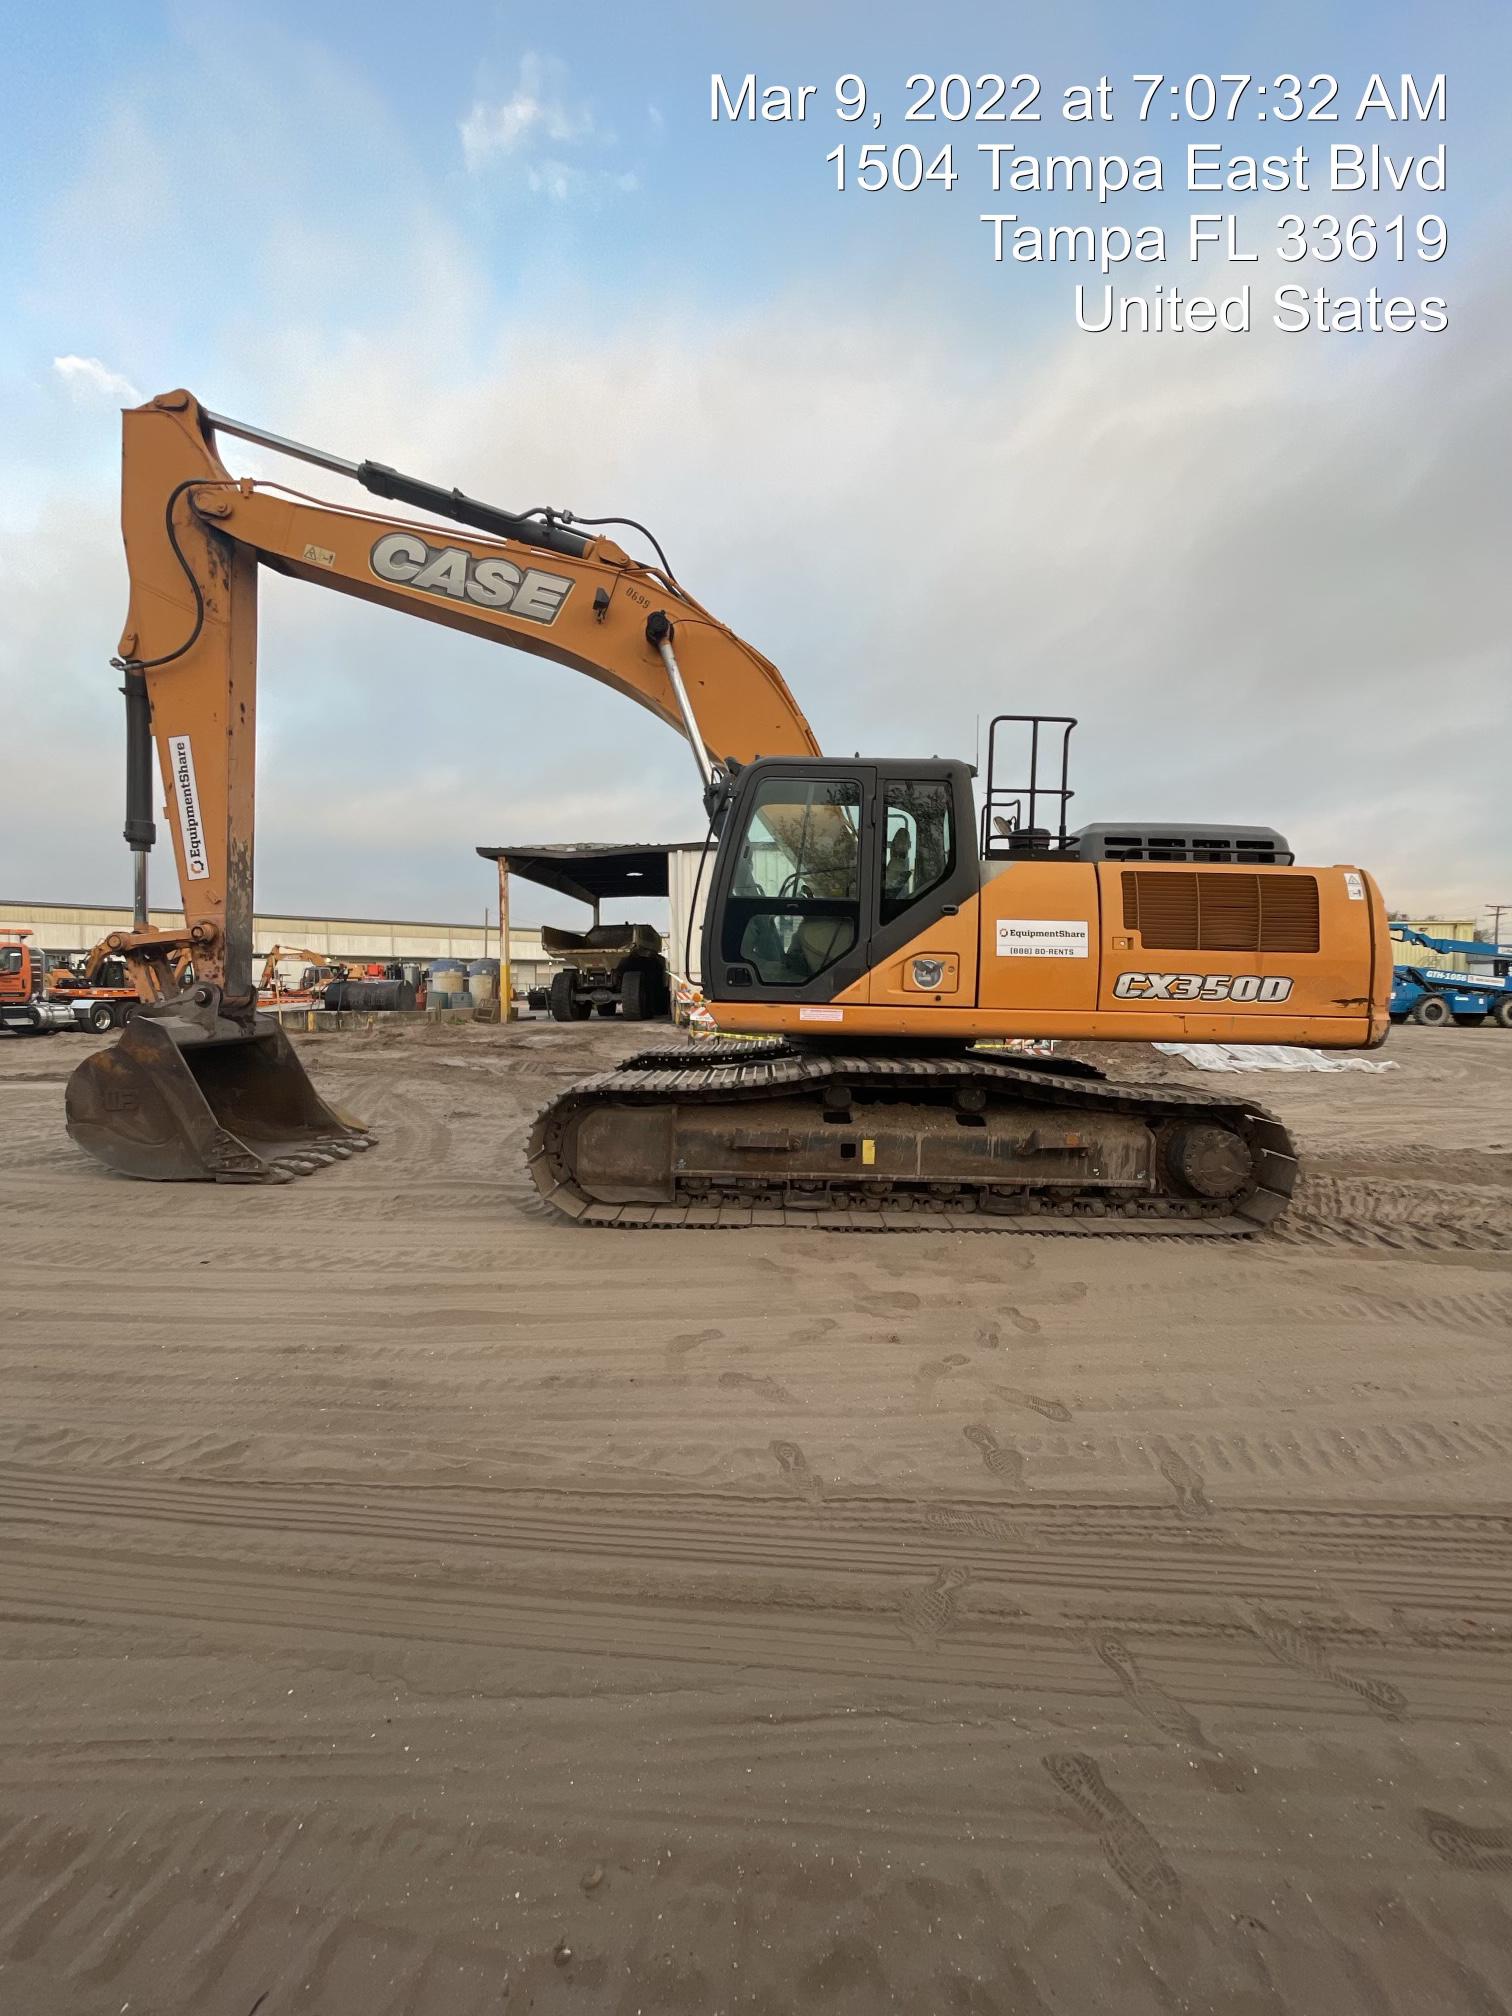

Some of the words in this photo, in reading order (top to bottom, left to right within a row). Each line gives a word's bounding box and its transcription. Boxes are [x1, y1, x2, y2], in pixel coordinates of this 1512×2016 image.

[372, 533, 572, 622] CASE
[176, 742, 201, 858] EquipmentShare
[1010, 929, 1085, 938] EquipmentShare
[1114, 972, 1294, 1002] CX350D
